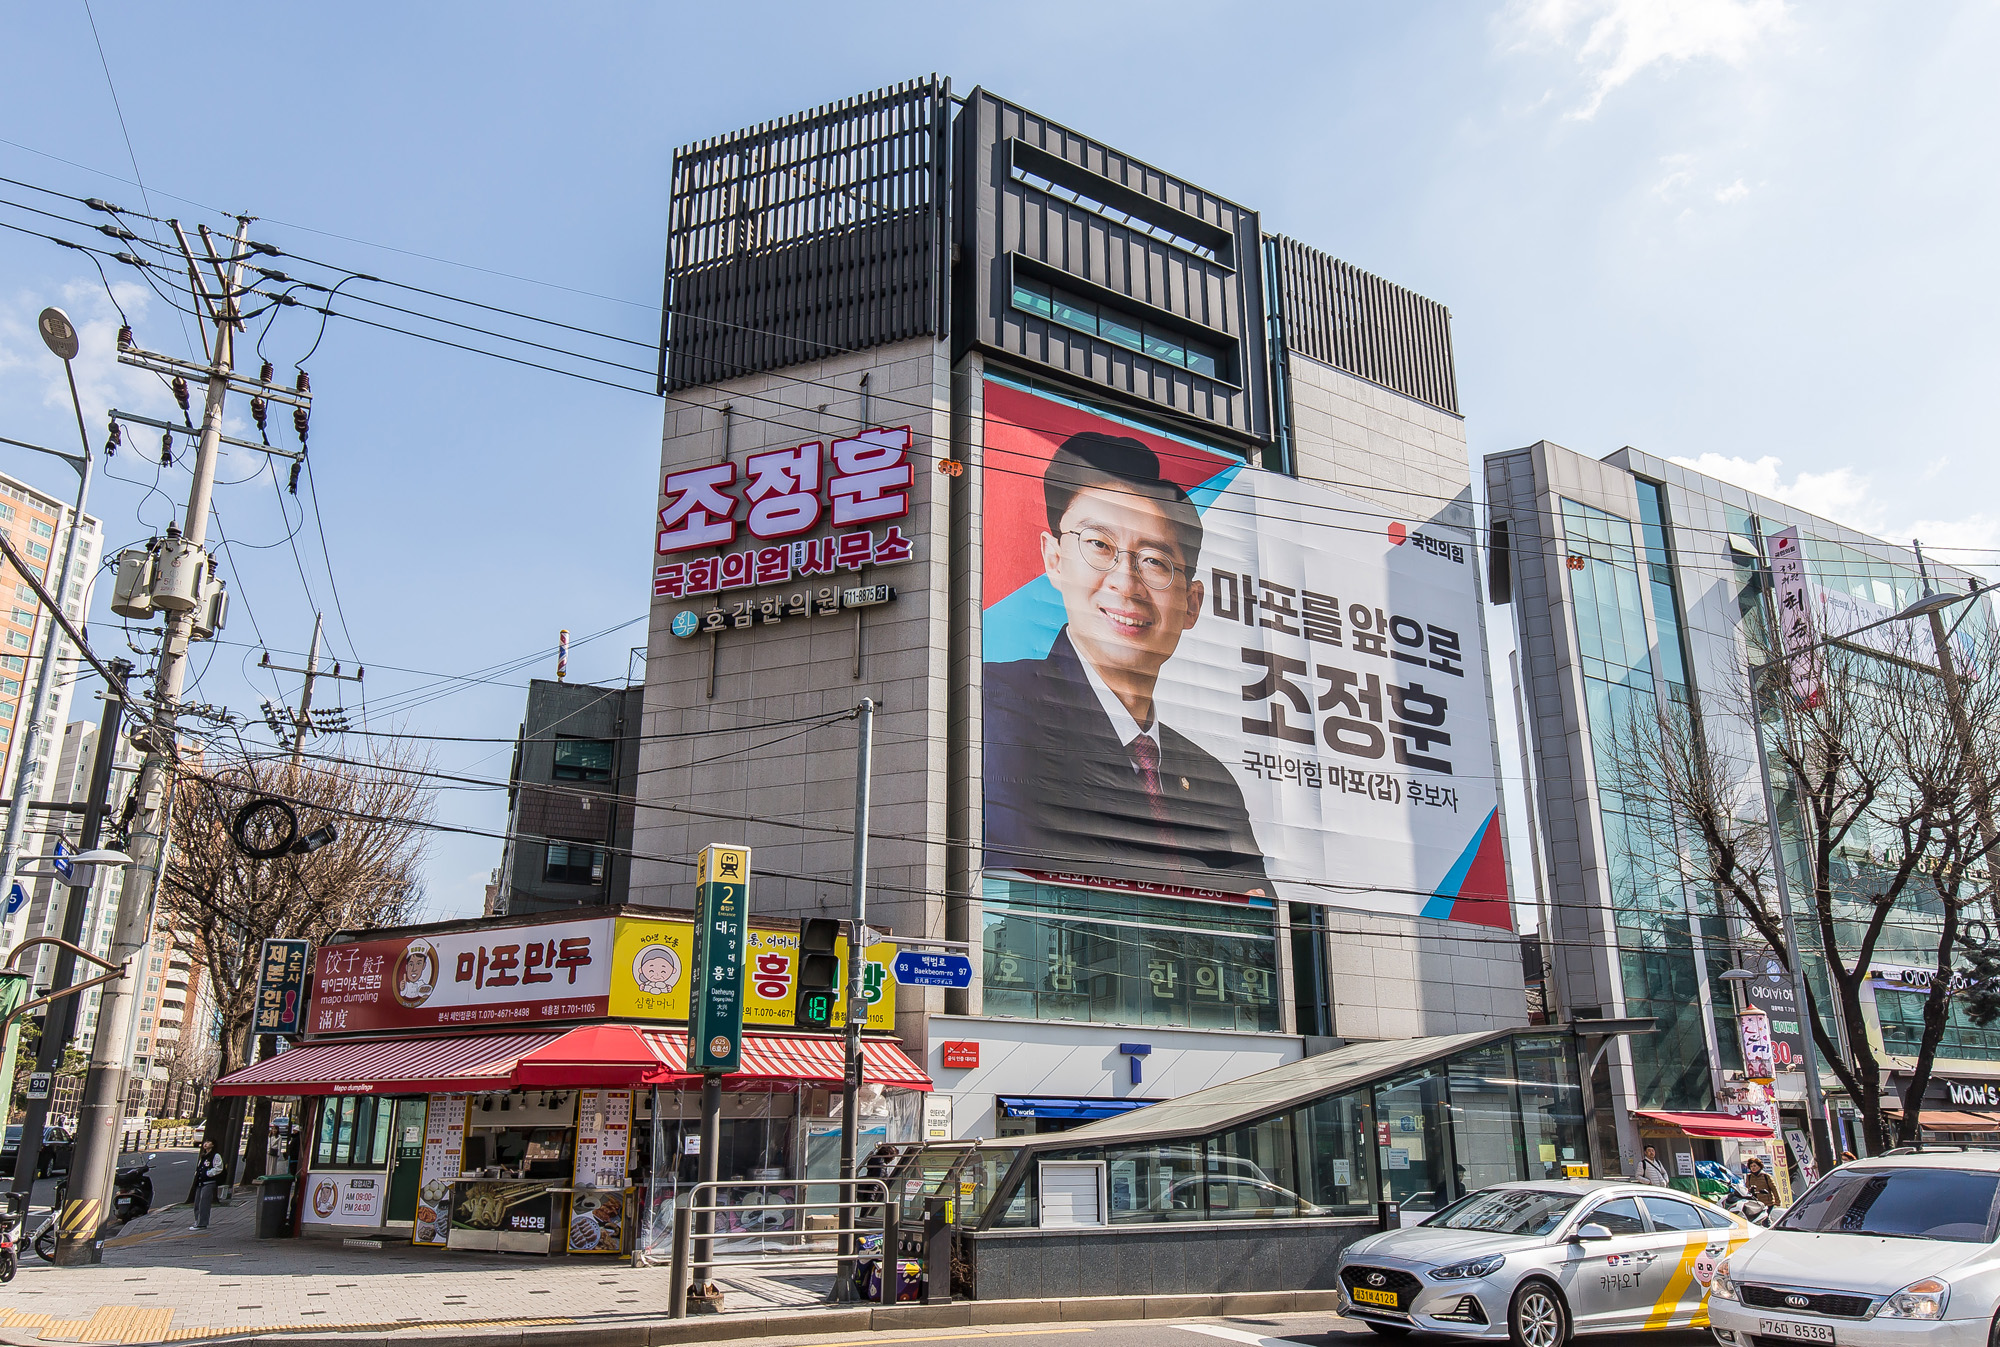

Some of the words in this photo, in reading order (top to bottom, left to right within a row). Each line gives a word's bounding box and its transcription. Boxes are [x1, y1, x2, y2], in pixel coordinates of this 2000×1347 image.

[656, 424, 914, 556] 조정훈
[1411, 531, 1465, 564] 국민의힘
[653, 543, 792, 599] 국회의원
[799, 526, 913, 577] 사무소
[703, 585, 840, 632] 호감한의원
[844, 586, 875, 604] 711-8875
[876, 585, 886, 599] 2F
[1211, 567, 1343, 648] 마포를
[1348, 603, 1465, 678] 앞으로
[1241, 647, 1453, 775] 조정훈
[1242, 750, 1322, 788] 국민의힘
[1328, 765, 1401, 805] 마포(갑)
[1407, 779, 1459, 813] 후보자
[722, 886, 734, 904] 2
[641, 933, 659, 944] 40년
[663, 934, 679, 948] 전통
[747, 933, 763, 949] 통,
[766, 935, 800, 950] 어머니
[287, 950, 303, 984] 수도사
[324, 947, 360, 976] 饺子
[362, 955, 385, 975] 餃子
[455, 936, 592, 991] 마포만두
[899, 963, 909, 972] 93
[921, 956, 947, 967] 백범로
[914, 967, 954, 977] Baekbeom-ro
[958, 968, 967, 976] 97
[1148, 958, 1270, 1004] 한의원
[320, 995, 342, 1006] mapo
[343, 991, 379, 1004] dumpling
[711, 988, 735, 997] Daeheung
[634, 997, 675, 1010] 심할머니
[808, 996, 827, 1021] 18
[438, 1012, 449, 1022] 분식
[478, 1007, 530, 1019] T.070-4671-8498
[541, 1005, 559, 1015] 대흥점
[561, 1003, 595, 1014] T.701-1105
[33, 1080, 46, 1088] 90
[333, 1084, 347, 1093] Mapo
[1950, 1083, 1999, 1106] MOM'S
[930, 1109, 945, 1117] 인터넷
[1803, 1166, 1818, 1185] 치
[344, 1203, 353, 1211] PM
[354, 1203, 371, 1212] 24:00
[511, 1215, 546, 1229] 부산오뎅
[1788, 1296, 1805, 1305] KIA
[1794, 1324, 1827, 1340] 8538
